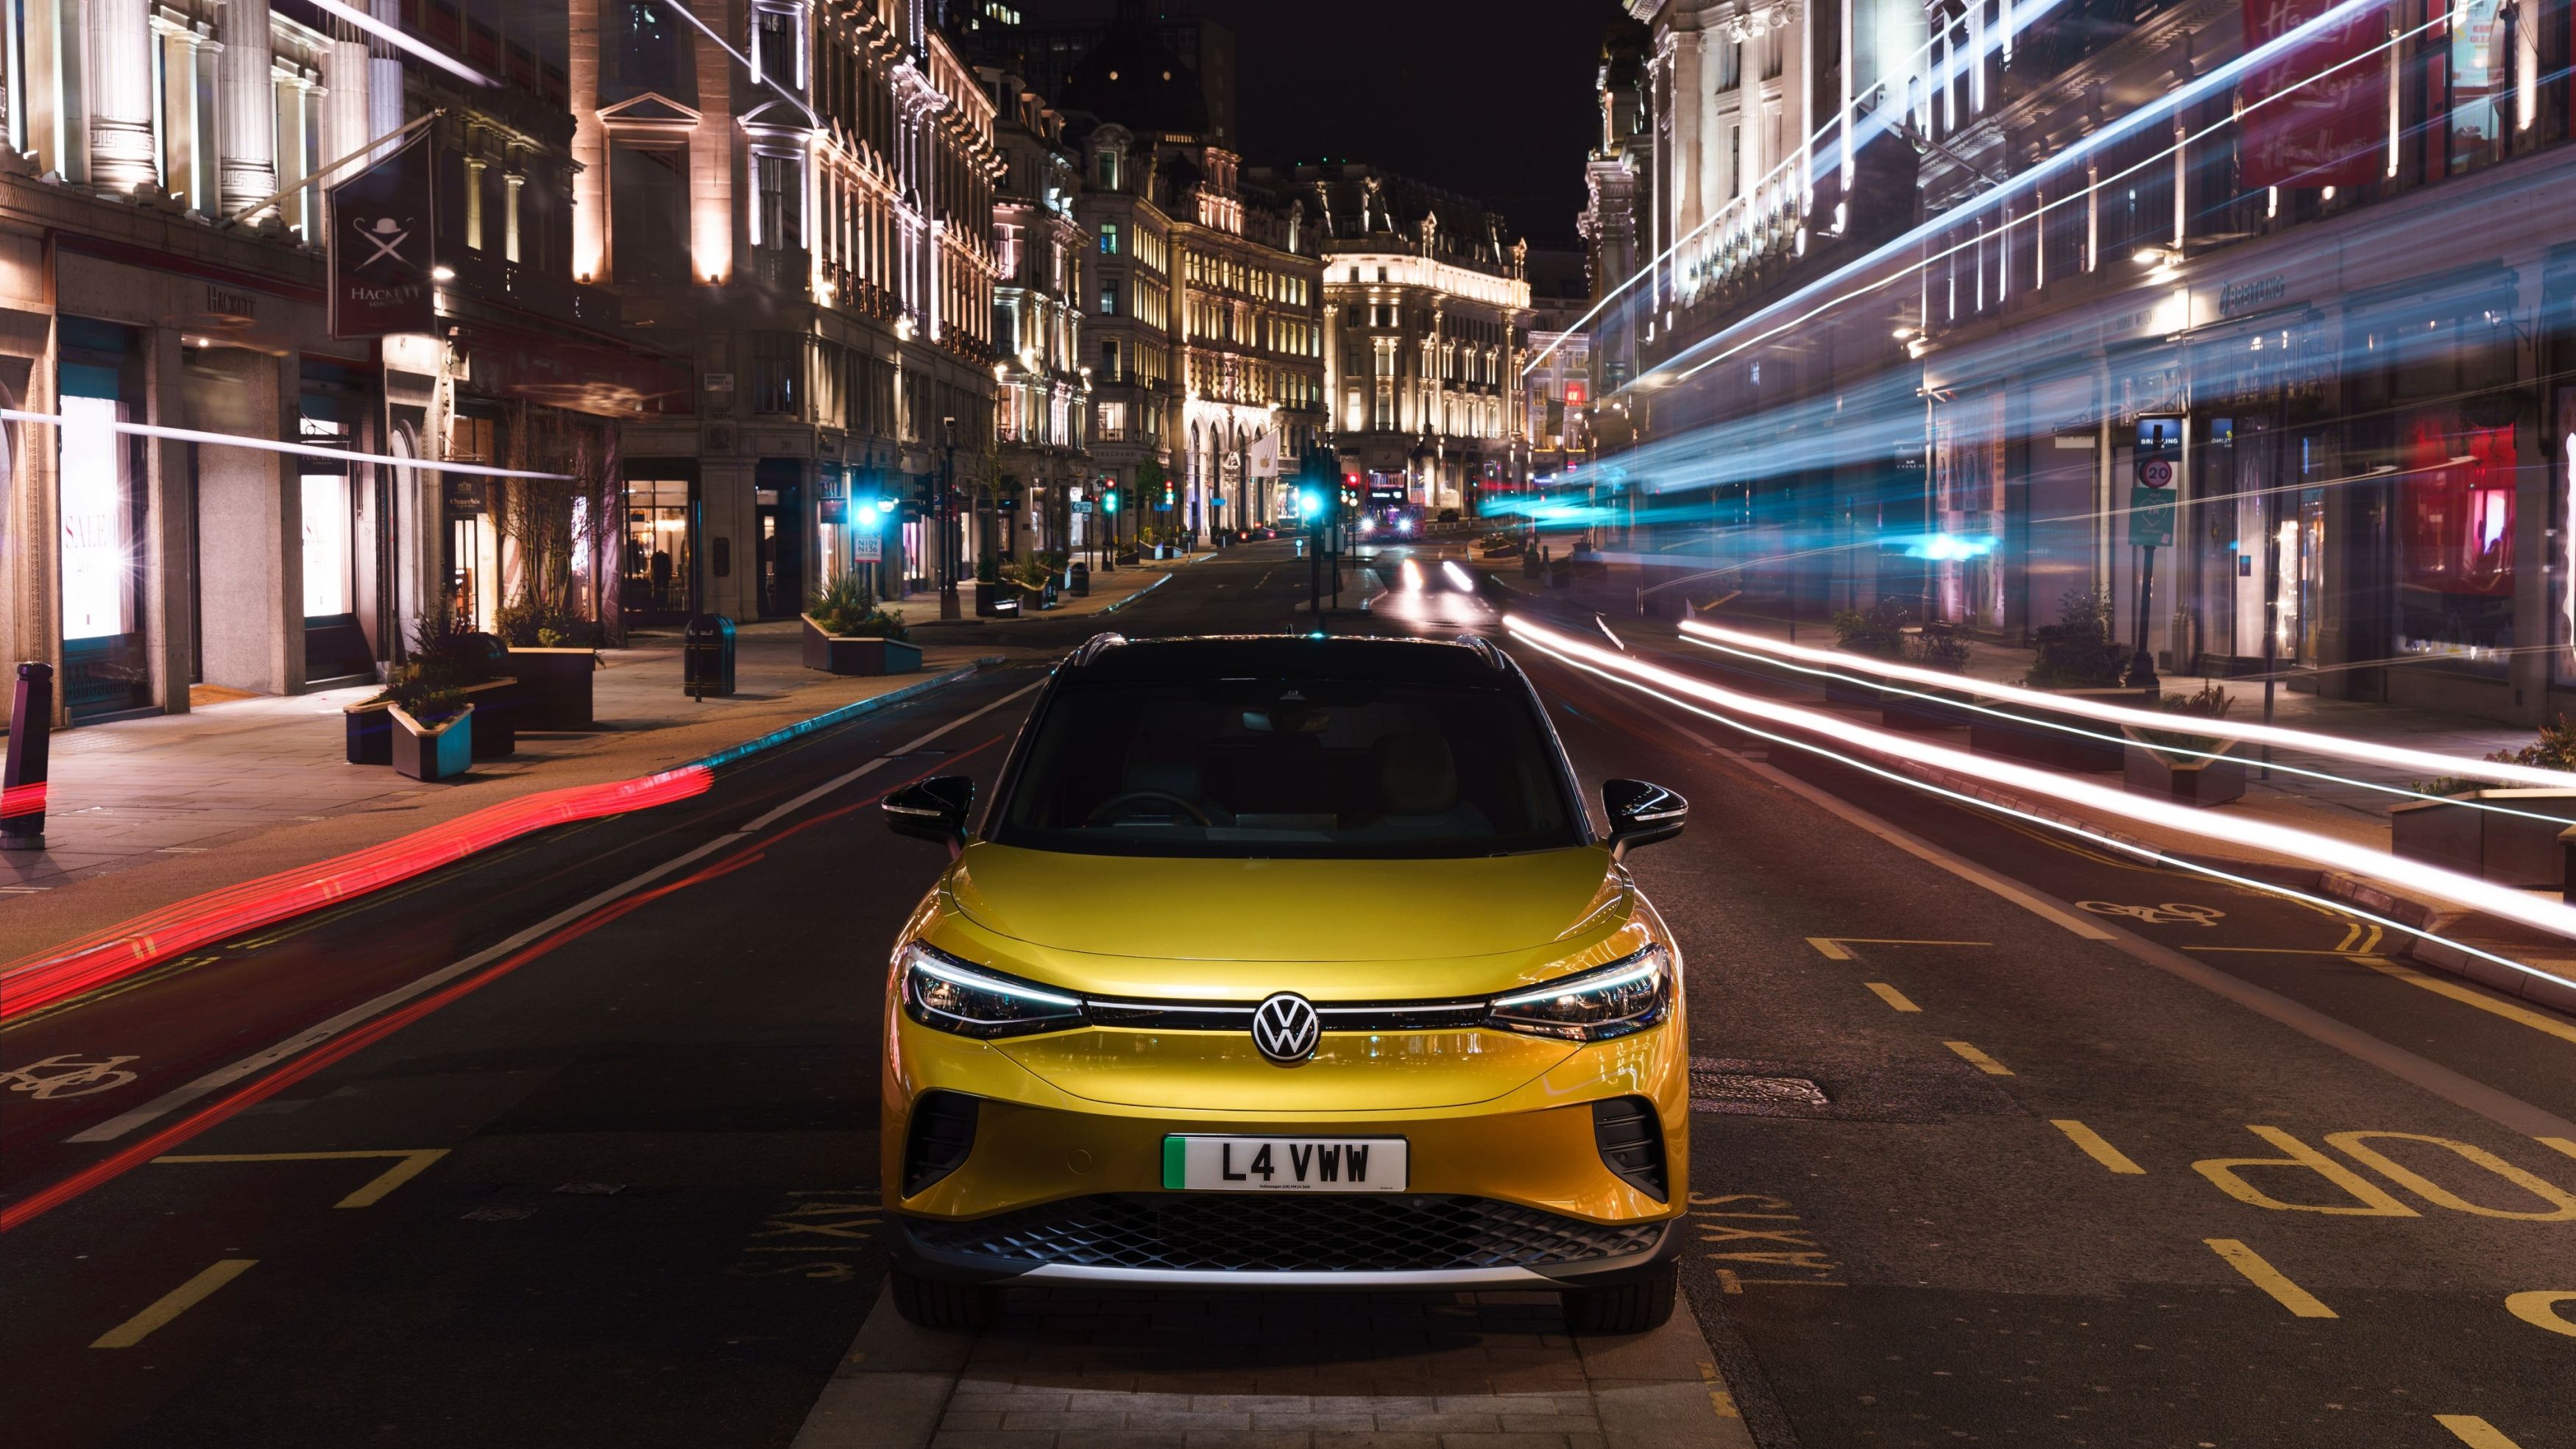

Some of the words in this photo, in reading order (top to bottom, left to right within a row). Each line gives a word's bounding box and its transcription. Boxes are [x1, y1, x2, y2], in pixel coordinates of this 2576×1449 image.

[2148, 467, 2168, 479] 20
[66, 514, 107, 548] SALE
[1222, 1143, 1275, 1182] L4
[1289, 1144, 1370, 1183] VWW
